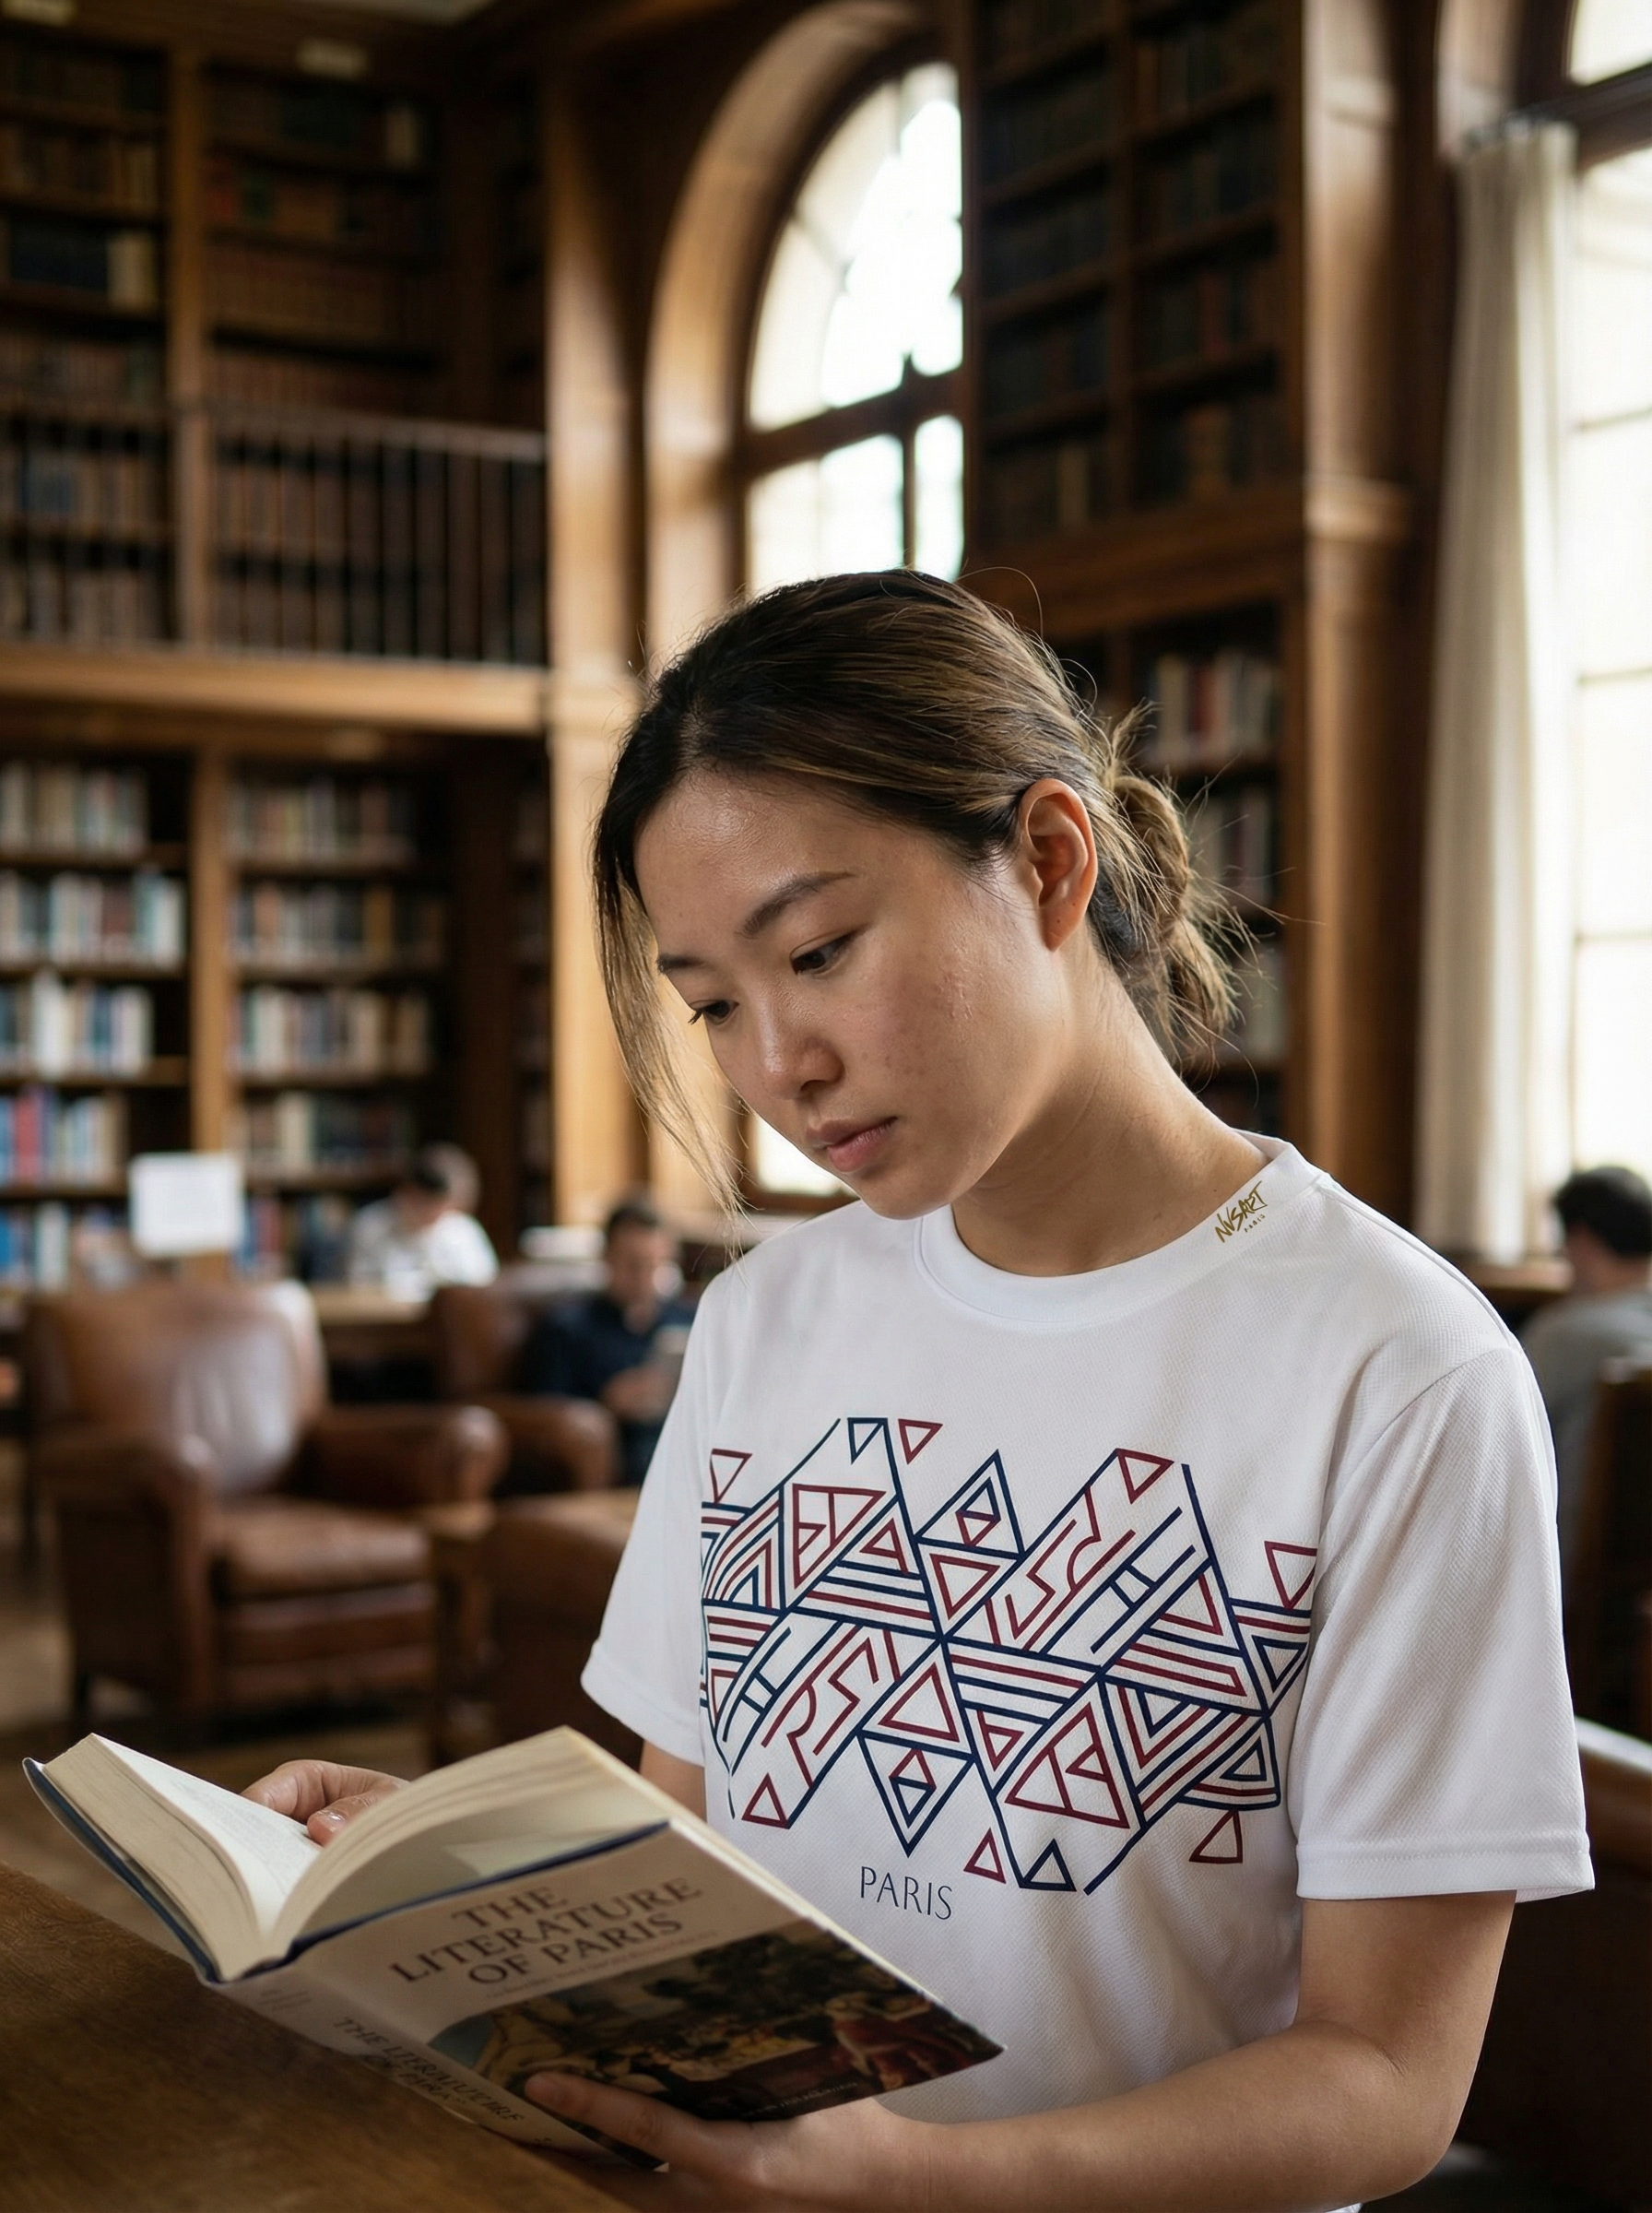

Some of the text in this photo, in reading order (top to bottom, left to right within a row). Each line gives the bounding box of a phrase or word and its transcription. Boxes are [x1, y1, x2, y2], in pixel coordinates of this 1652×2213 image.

[451, 1886, 568, 1929] THE
[860, 1865, 952, 1920] PARIS
[389, 1877, 703, 1982] LITERATURE
[467, 1953, 529, 1984] OF
[541, 1912, 683, 1965] PARIS
